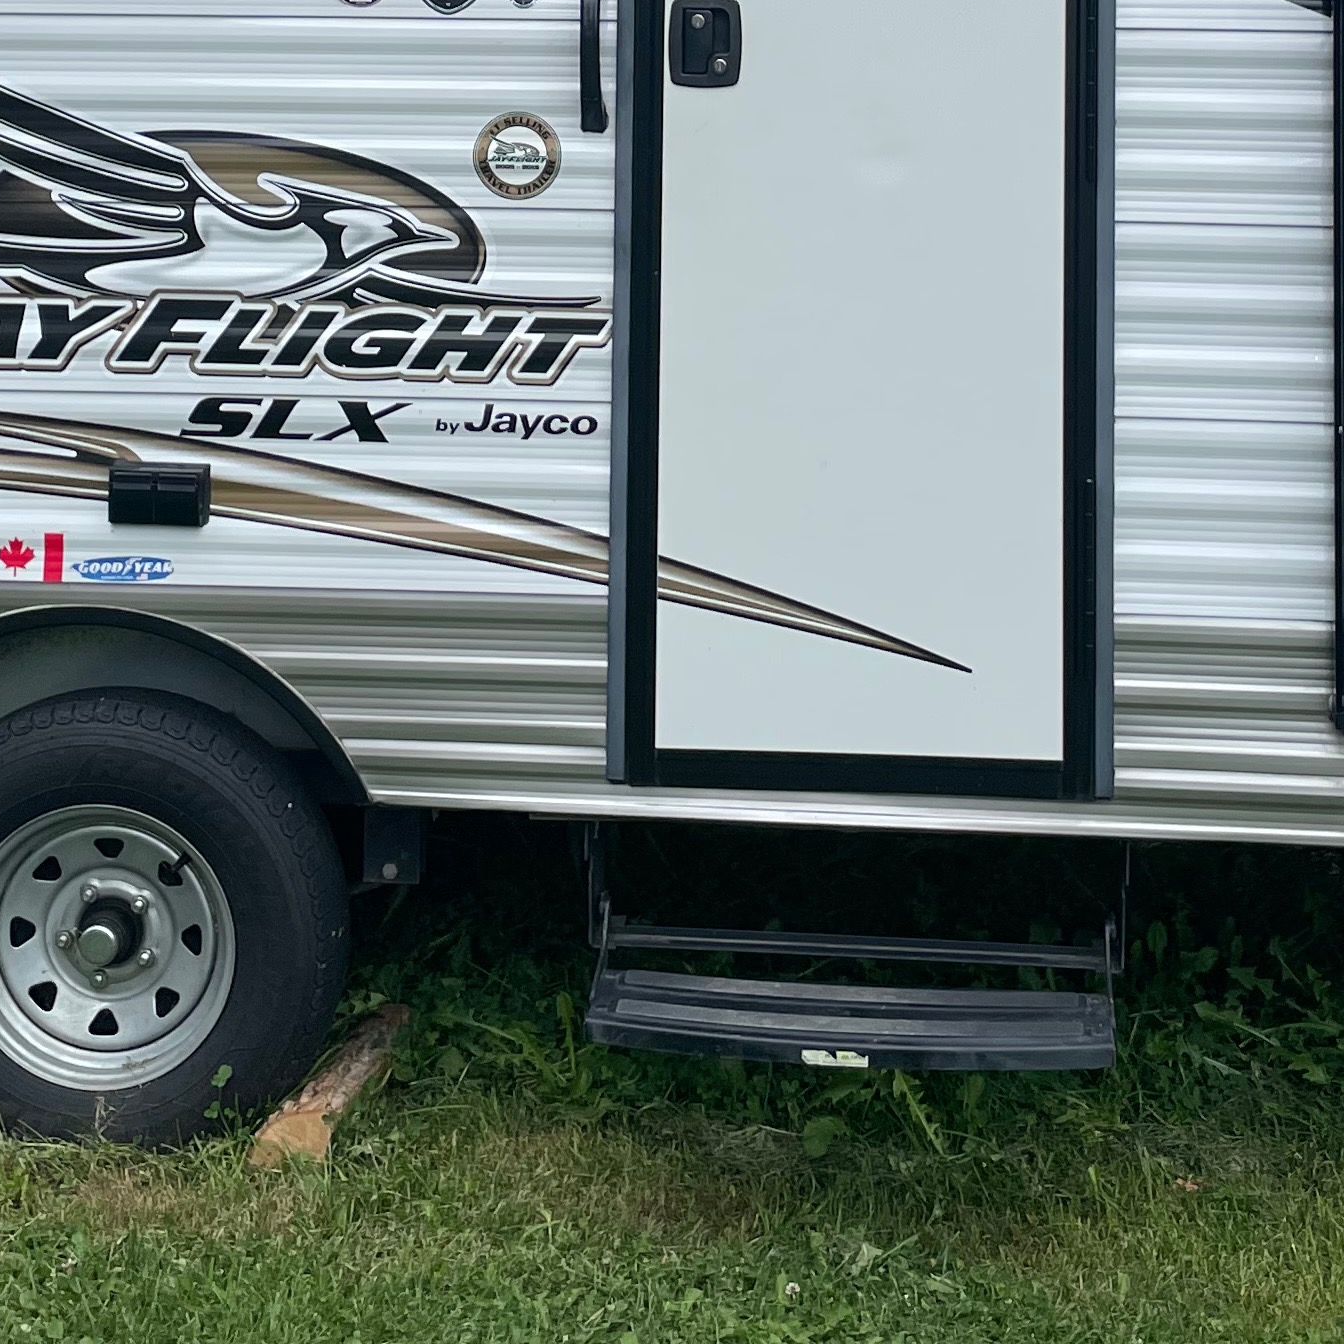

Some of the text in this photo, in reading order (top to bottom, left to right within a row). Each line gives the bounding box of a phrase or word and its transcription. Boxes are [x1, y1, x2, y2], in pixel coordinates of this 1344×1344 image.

[503, 116, 551, 140] SELLING
[108, 292, 611, 383] FLIGHT
[179, 397, 413, 443] SLX
[435, 403, 599, 440] by Jayco
